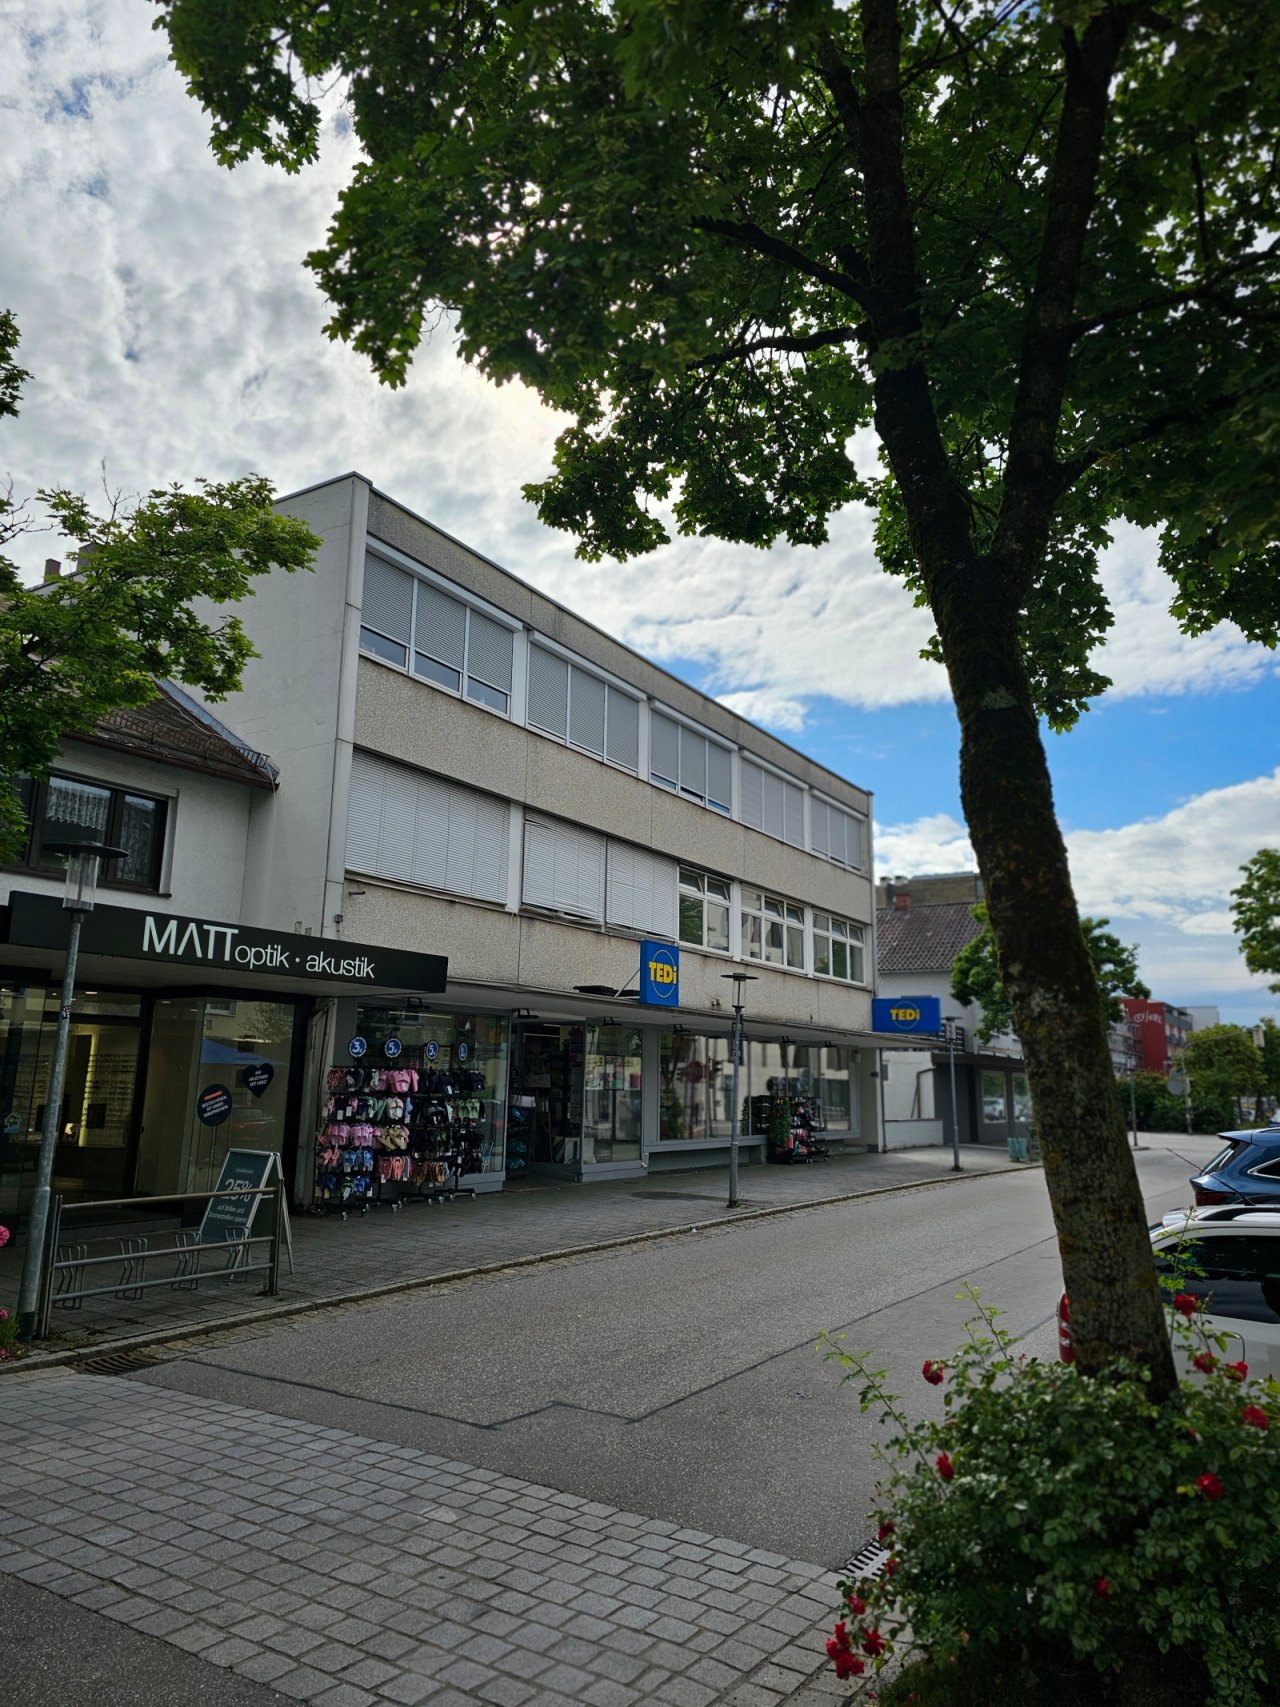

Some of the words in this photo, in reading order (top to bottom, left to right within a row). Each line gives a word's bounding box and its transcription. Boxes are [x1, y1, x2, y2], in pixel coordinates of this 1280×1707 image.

[234, 944, 290, 970] optik
[305, 951, 375, 979] akustik
[648, 961, 677, 985] TEDi
[889, 1008, 921, 1021] TEDi
